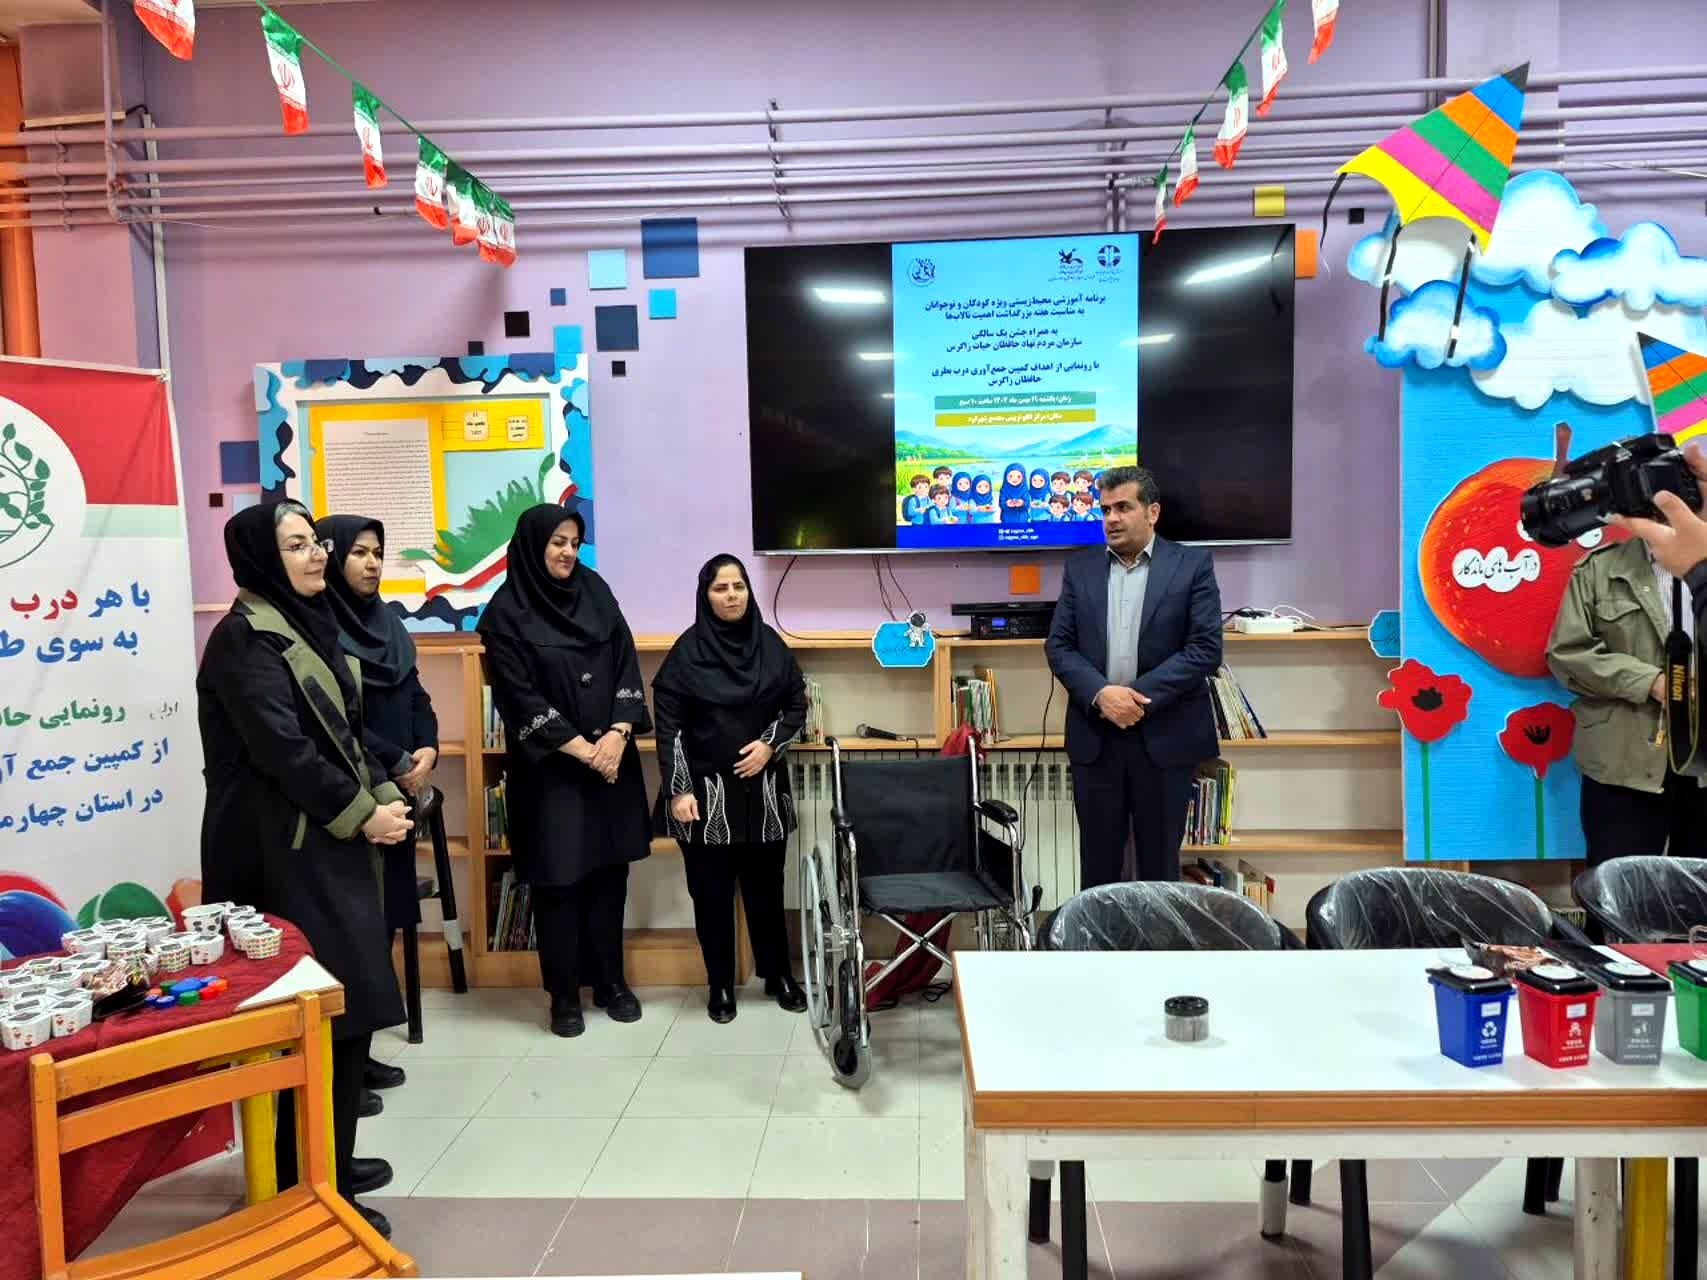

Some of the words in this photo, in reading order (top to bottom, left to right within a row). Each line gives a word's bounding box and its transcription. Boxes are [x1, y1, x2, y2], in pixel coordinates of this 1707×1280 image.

[962, 298, 989, 310] کودکان
[990, 298, 1006, 308] ویژه
[1052, 294, 1082, 306] آموزشی
[1085, 294, 1105, 304] برنامه
[924, 300, 956, 312] نوجوانان
[956, 302, 961, 310] و
[1050, 306, 1075, 317] مناسبت
[971, 310, 995, 320] اهمیت
[971, 330, 994, 340] سالگی
[995, 330, 1007, 338] یک
[1008, 328, 1027, 338] جشن
[1028, 328, 1048, 338] همراه
[1020, 340, 1035, 348] نهاد
[1056, 338, 1082, 348] سازمان
[953, 366, 969, 376] درب
[1008, 364, 1028, 375] کمپین
[1030, 363, 1054, 372] اهداف
[1056, 362, 1062, 372] از
[1064, 360, 1092, 372] رونمایی
[130, 581, 150, 613] با
[10, 589, 78, 620] درب
[88, 589, 124, 618] هر
[113, 630, 138, 656] به
[36, 636, 104, 664] سوی
[40, 698, 126, 730] رونمایی
[84, 740, 144, 772] کمپین
[152, 737, 169, 764] از
[26, 754, 76, 780] جمع
[75, 788, 133, 822] استان
[140, 788, 164, 813] در
[0, 803, 67, 834] چهارم
